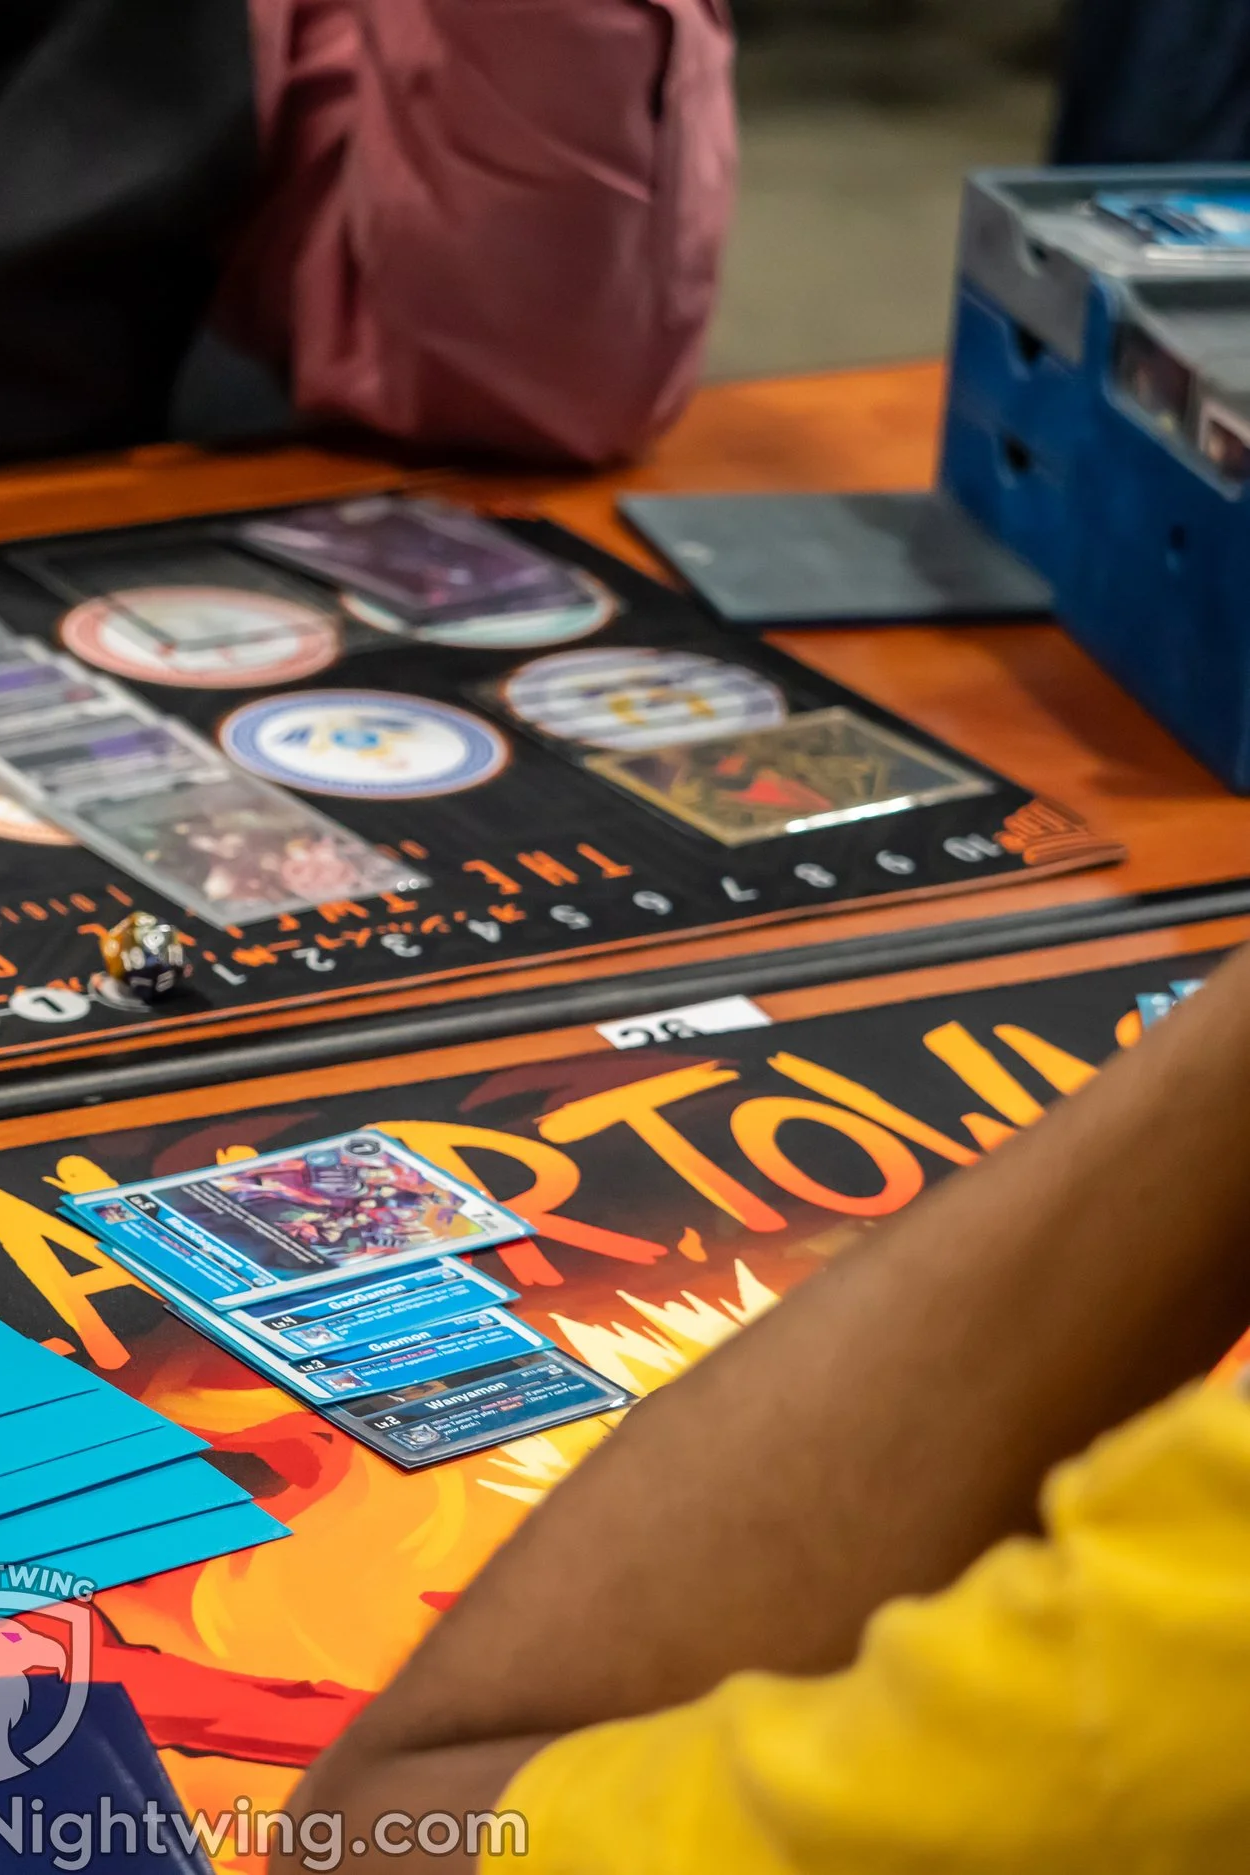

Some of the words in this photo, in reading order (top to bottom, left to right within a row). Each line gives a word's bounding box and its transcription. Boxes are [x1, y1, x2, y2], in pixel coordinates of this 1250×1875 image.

[463, 842, 632, 895] THE
[876, 850, 916, 874] 9
[794, 863, 836, 888] 8
[721, 876, 758, 902] 7
[633, 890, 672, 915] 6
[550, 904, 592, 929] 5
[467, 919, 501, 943] 4
[380, 933, 422, 958] 3
[291, 947, 336, 972] 2
[30, 996, 64, 1015] 1
[327, 1281, 406, 1311] GaoGamon
[299, 1360, 325, 1373] Lv.3
[367, 1331, 432, 1352] Gaomon
[373, 1415, 400, 1429] Lv.2
[424, 1381, 509, 1409] Wanyamon
